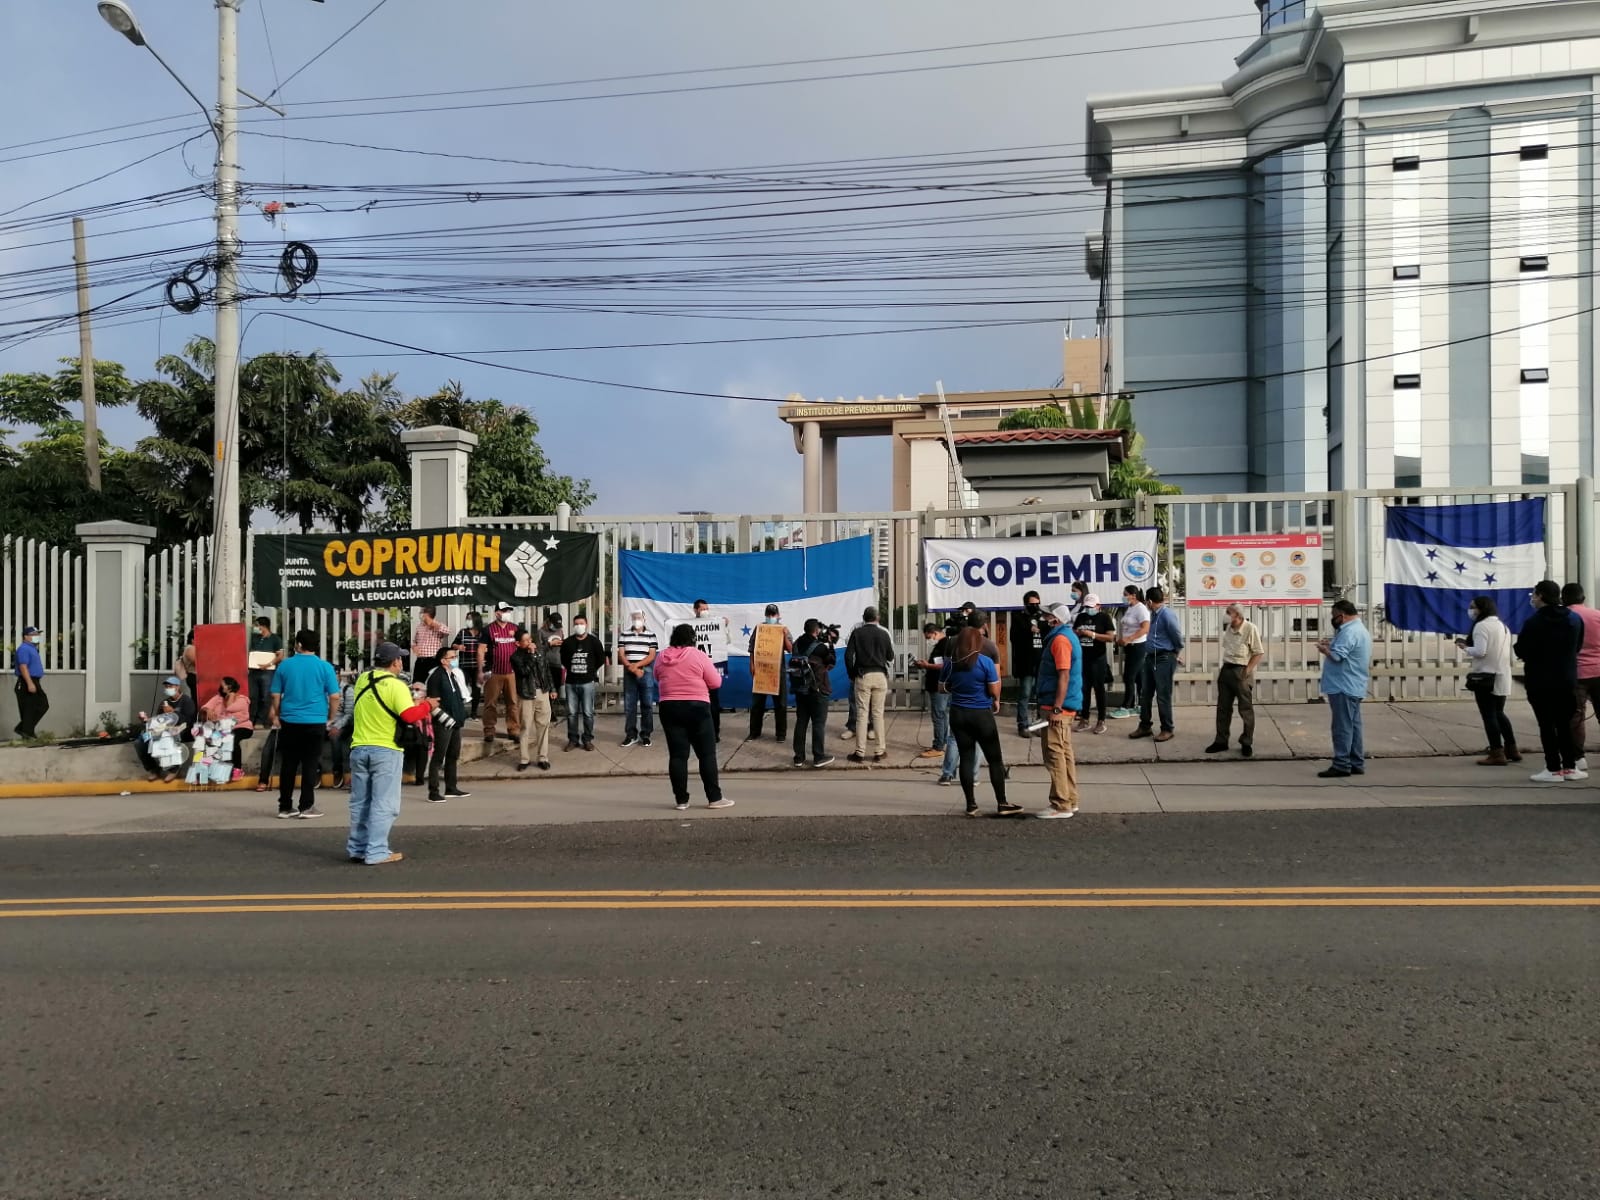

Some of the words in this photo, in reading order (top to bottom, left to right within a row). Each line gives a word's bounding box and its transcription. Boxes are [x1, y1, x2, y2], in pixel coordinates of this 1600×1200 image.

[796, 407, 832, 416] INSTITUTO
[835, 406, 844, 415] DE
[324, 533, 500, 576] COPRUMH
[279, 568, 316, 576] DIRECTIVA
[963, 553, 1119, 587] COPEMH
[280, 579, 314, 587] ENTRAL
[336, 580, 387, 589] PRESENTE
[390, 579, 402, 587] EN
[405, 578, 418, 587] LA
[421, 575, 469, 585] DEFENSA
[473, 575, 487, 584] DE
[352, 593, 365, 601] LA
[367, 589, 424, 600] EDUCACIÓN
[427, 586, 473, 598] PÚBLICA
